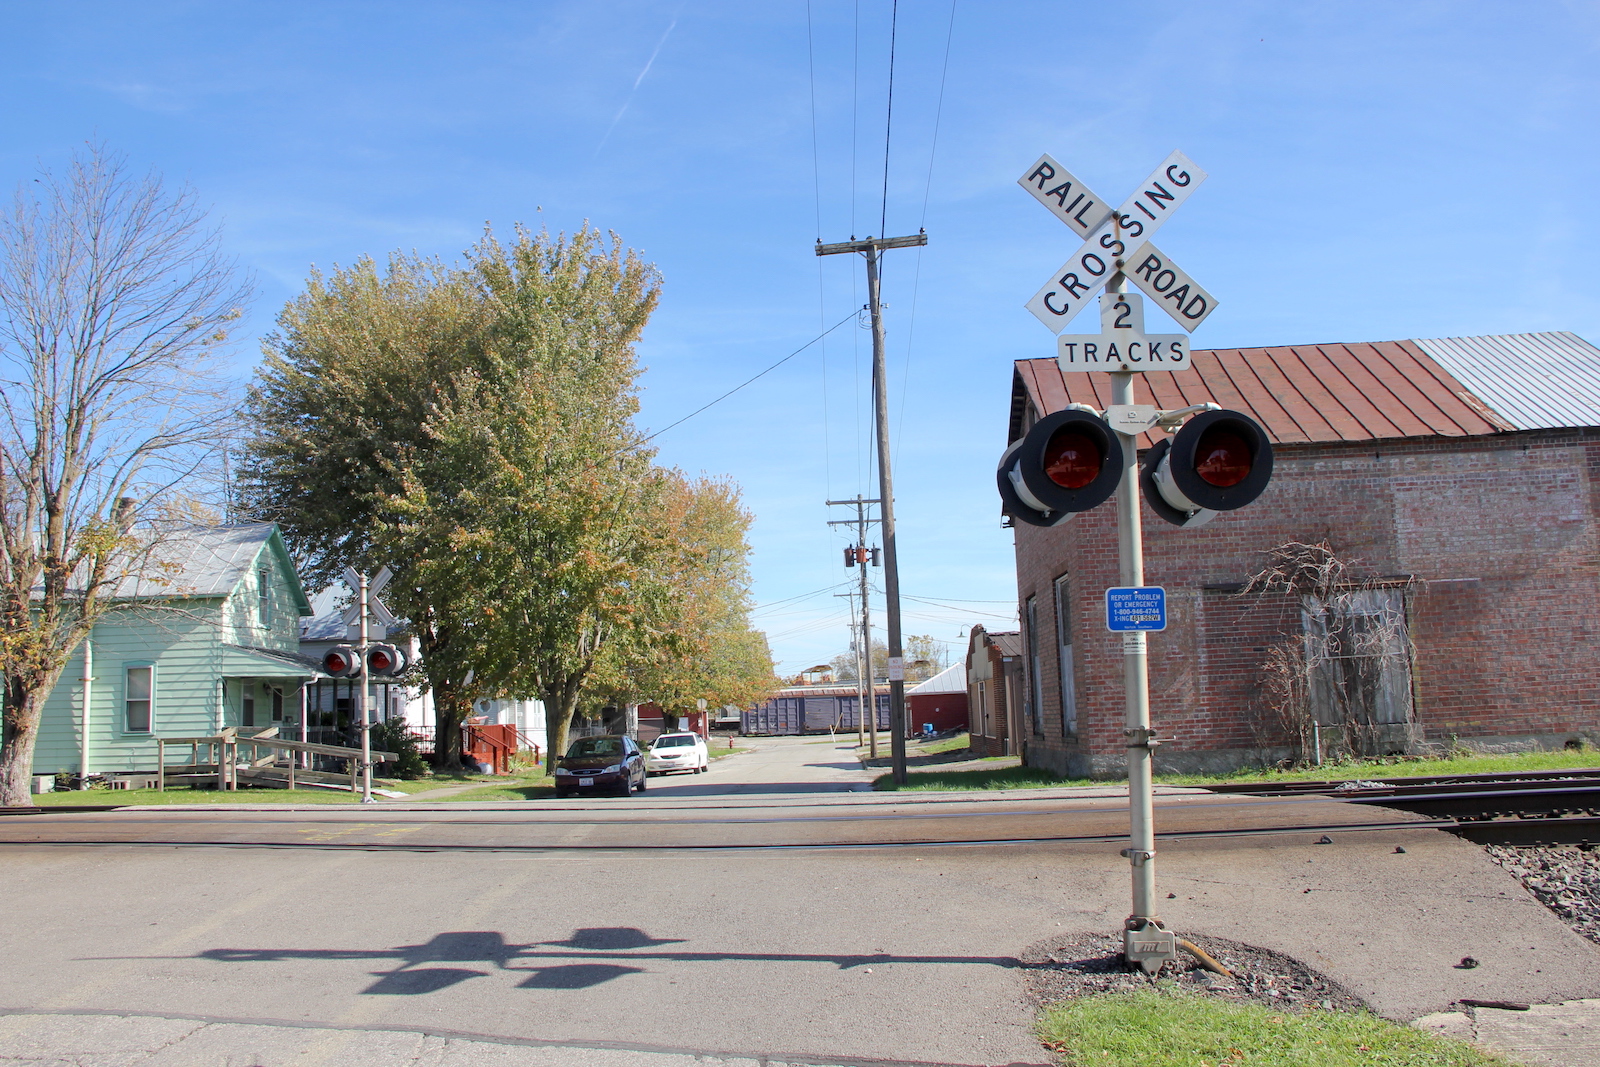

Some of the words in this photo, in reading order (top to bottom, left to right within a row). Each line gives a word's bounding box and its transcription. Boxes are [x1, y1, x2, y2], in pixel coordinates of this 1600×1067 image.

[1028, 161, 1094, 229] RAIL
[1135, 253, 1207, 320] ROAD
[1044, 164, 1191, 316] CROSSING
[1065, 341, 1184, 363] TRACKS
[1113, 302, 1132, 329] 2
